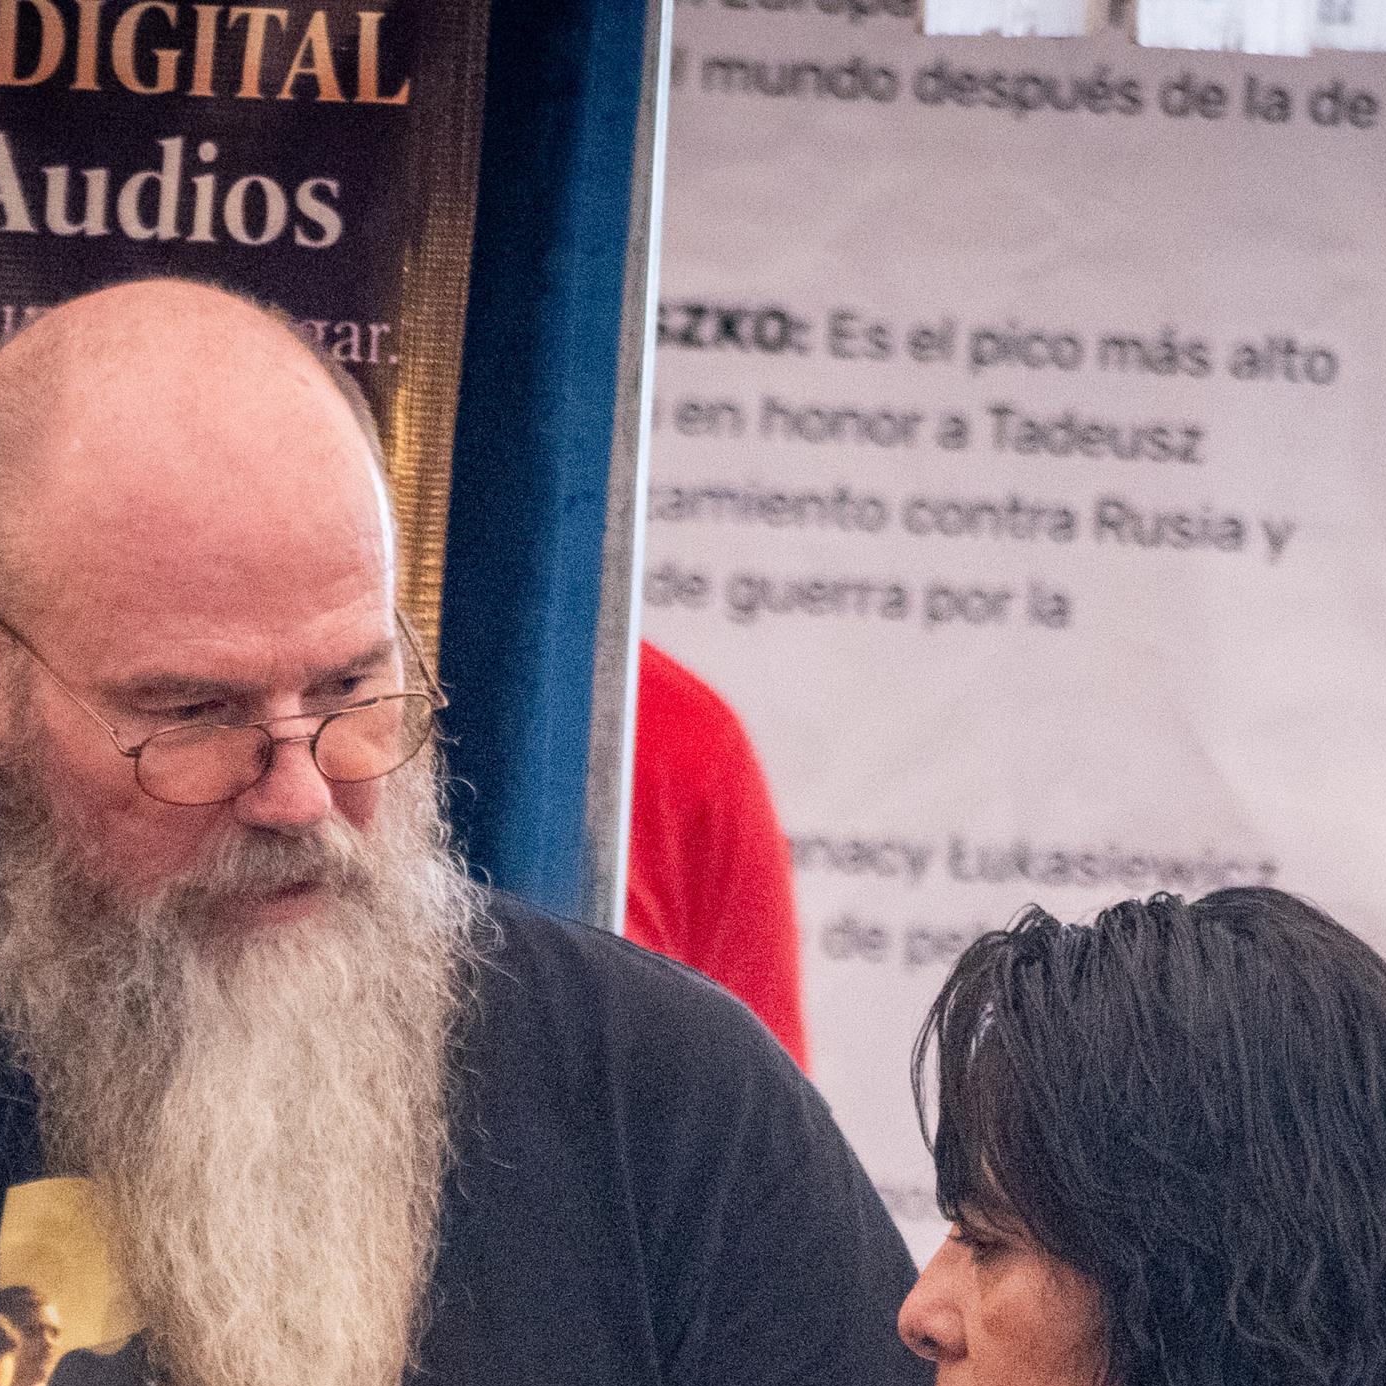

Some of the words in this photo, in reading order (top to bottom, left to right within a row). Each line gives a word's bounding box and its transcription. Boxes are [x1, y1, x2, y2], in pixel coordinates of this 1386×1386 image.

[701, 56, 899, 102] mundo
[914, 57, 1143, 120] después
[1159, 71, 1229, 120] de
[1243, 71, 1293, 124] la
[1308, 77, 1381, 129] de
[826, 309, 893, 361] Es
[906, 318, 956, 363] el
[967, 320, 1083, 377] pico
[1096, 324, 1213, 379] más
[1228, 334, 1340, 386] alto
[674, 398, 746, 439] en
[761, 396, 925, 448] honor
[936, 413, 970, 451] a
[985, 401, 1205, 466] Tadeusz
[902, 495, 1077, 544] contra
[1092, 495, 1249, 552] Rusia
[1260, 516, 1297, 567] y
[726, 573, 909, 627] guerra
[924, 581, 1014, 629] por
[1028, 576, 1074, 630] la
